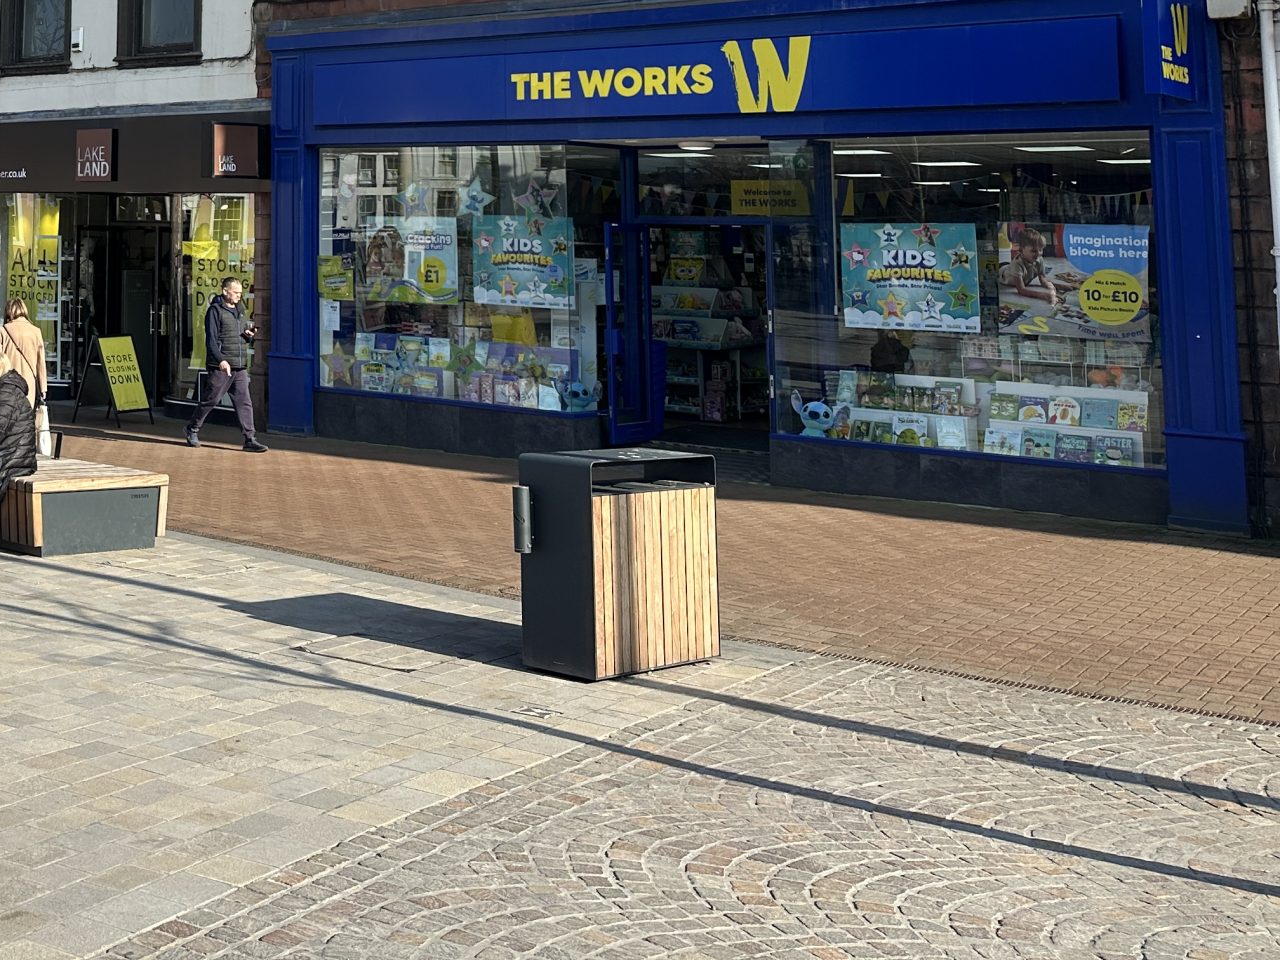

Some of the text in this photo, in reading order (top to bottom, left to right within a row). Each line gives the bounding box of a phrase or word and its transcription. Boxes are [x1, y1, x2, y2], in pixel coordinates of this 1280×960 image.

[1161, 45, 1173, 61] THE
[511, 36, 811, 113] THE WORKS W
[1161, 61, 1189, 85] WORKS
[77, 146, 106, 162] LAKE
[218, 155, 235, 164] LAKE
[77, 161, 109, 178] LAND
[218, 162, 237, 172] LAND
[744, 188, 781, 196] Welcome
[739, 199, 797, 208] THE WORKS
[407, 233, 452, 244] Cracking
[502, 238, 543, 253] KIDS
[1070, 234, 1148, 247] Imagination
[491, 253, 554, 265] FAVOURITES
[881, 249, 937, 267] KIDS
[1070, 246, 1148, 259] blooms here
[11, 248, 48, 272] ALL
[197, 258, 248, 274] STORE
[424, 269, 439, 283] £1
[866, 267, 953, 281] FAVOURITES
[10, 274, 54, 290] STOCK
[196, 276, 250, 290] CLOG
[10, 290, 53, 301] REDUCED
[196, 291, 249, 310] DON
[1084, 289, 1102, 301] 10
[1111, 290, 1139, 304] £10
[105, 353, 133, 364] STORE
[107, 364, 137, 373] CLOSING
[110, 373, 140, 385] DOWN
